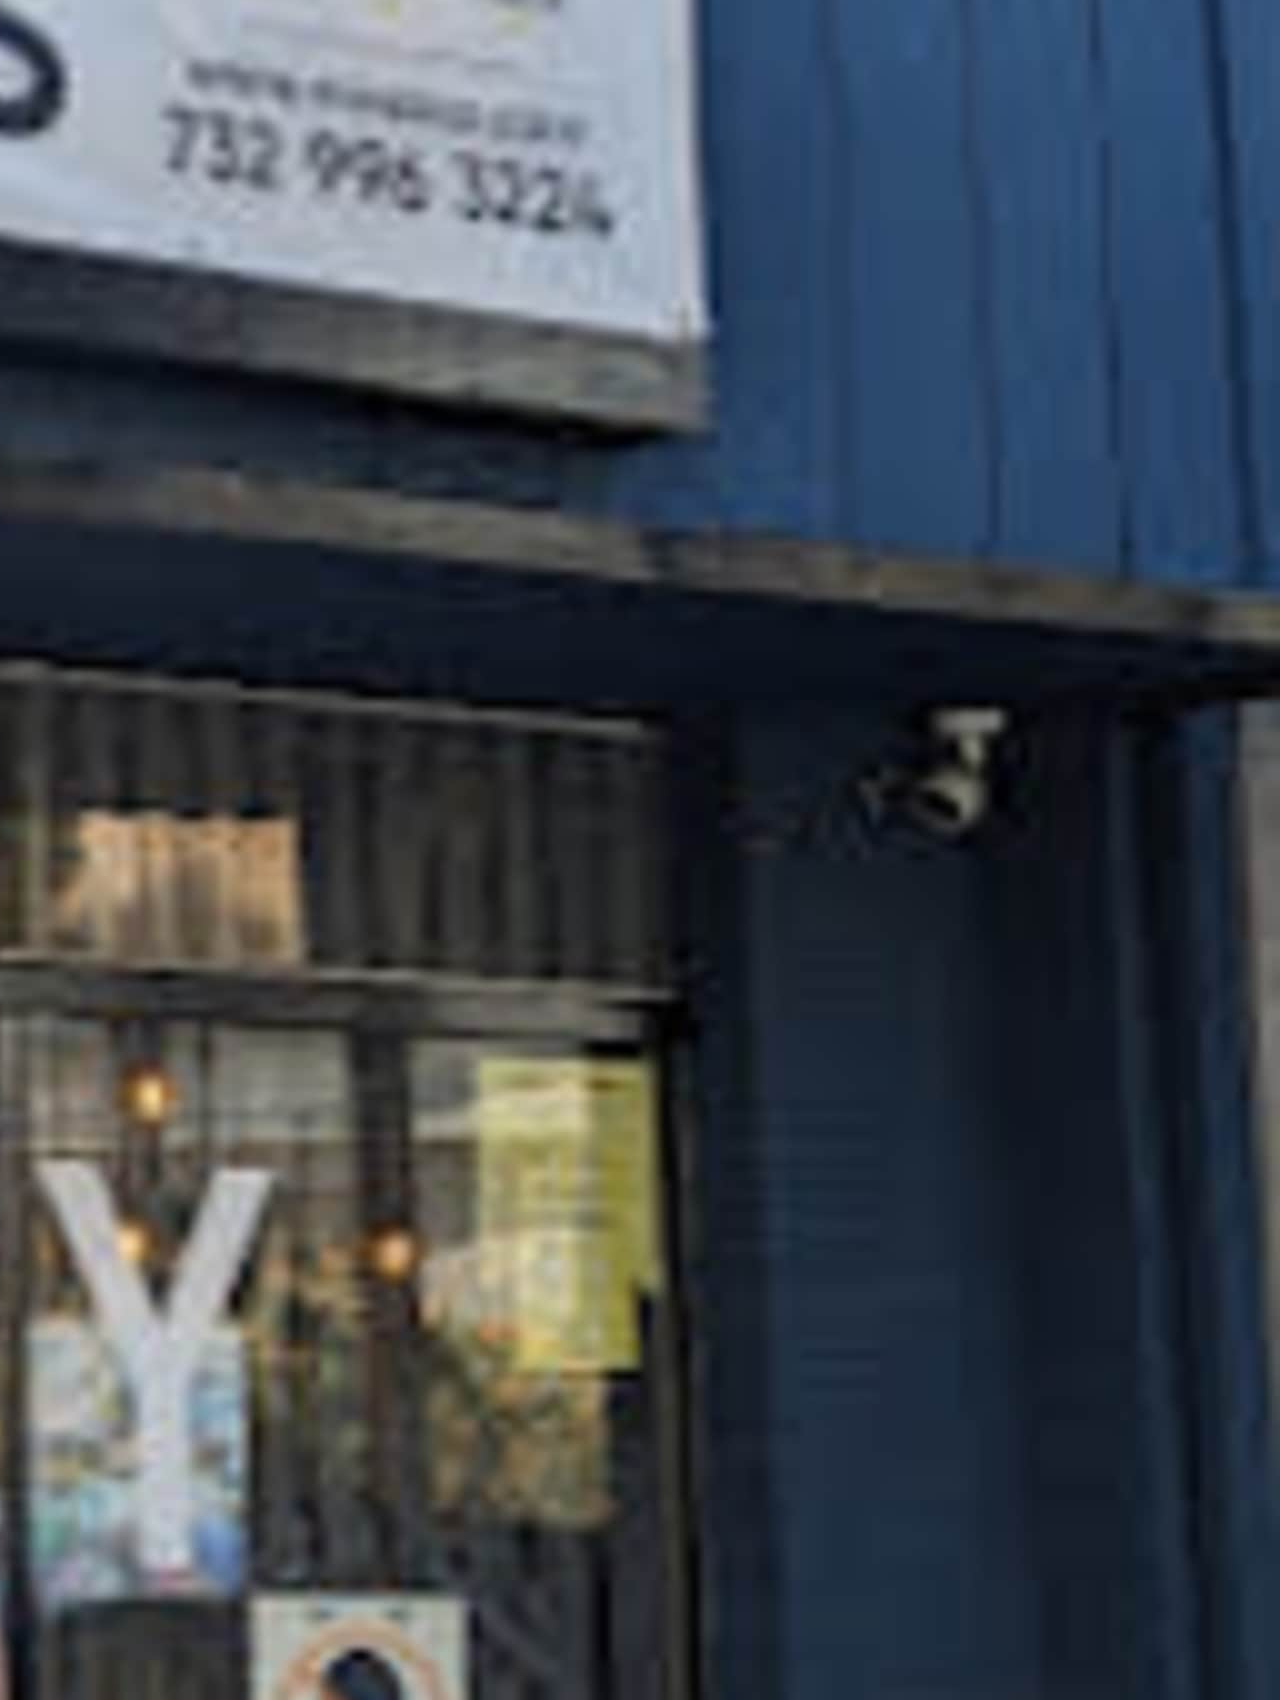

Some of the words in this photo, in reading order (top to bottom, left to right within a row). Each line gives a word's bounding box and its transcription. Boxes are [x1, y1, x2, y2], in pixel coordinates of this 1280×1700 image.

[160, 102, 284, 194] 732
[305, 128, 431, 215] 996
[449, 147, 616, 240] 3224
